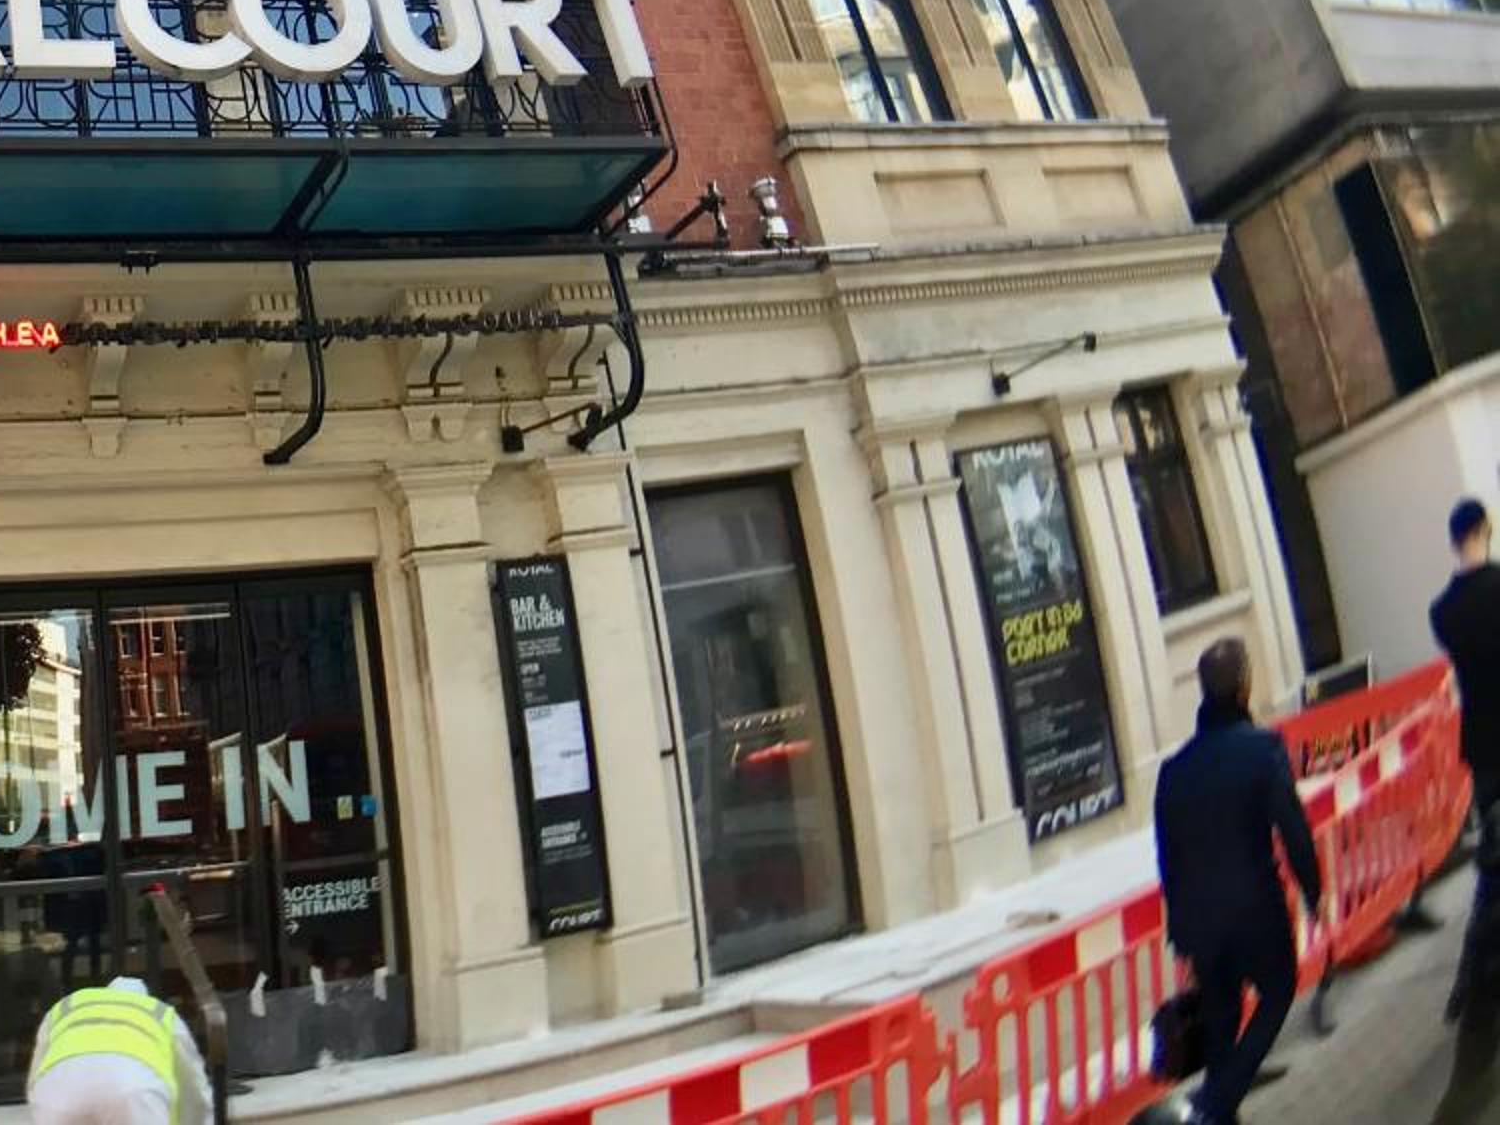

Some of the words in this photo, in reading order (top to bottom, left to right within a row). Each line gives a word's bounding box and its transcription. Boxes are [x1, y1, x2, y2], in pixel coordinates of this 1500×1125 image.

[510, 596, 537, 617] BAR
[513, 607, 566, 633] KITCHEN
[222, 739, 312, 831] IN
[282, 876, 387, 902] ACCESSIBLE
[283, 893, 370, 920] ENTRANCE
